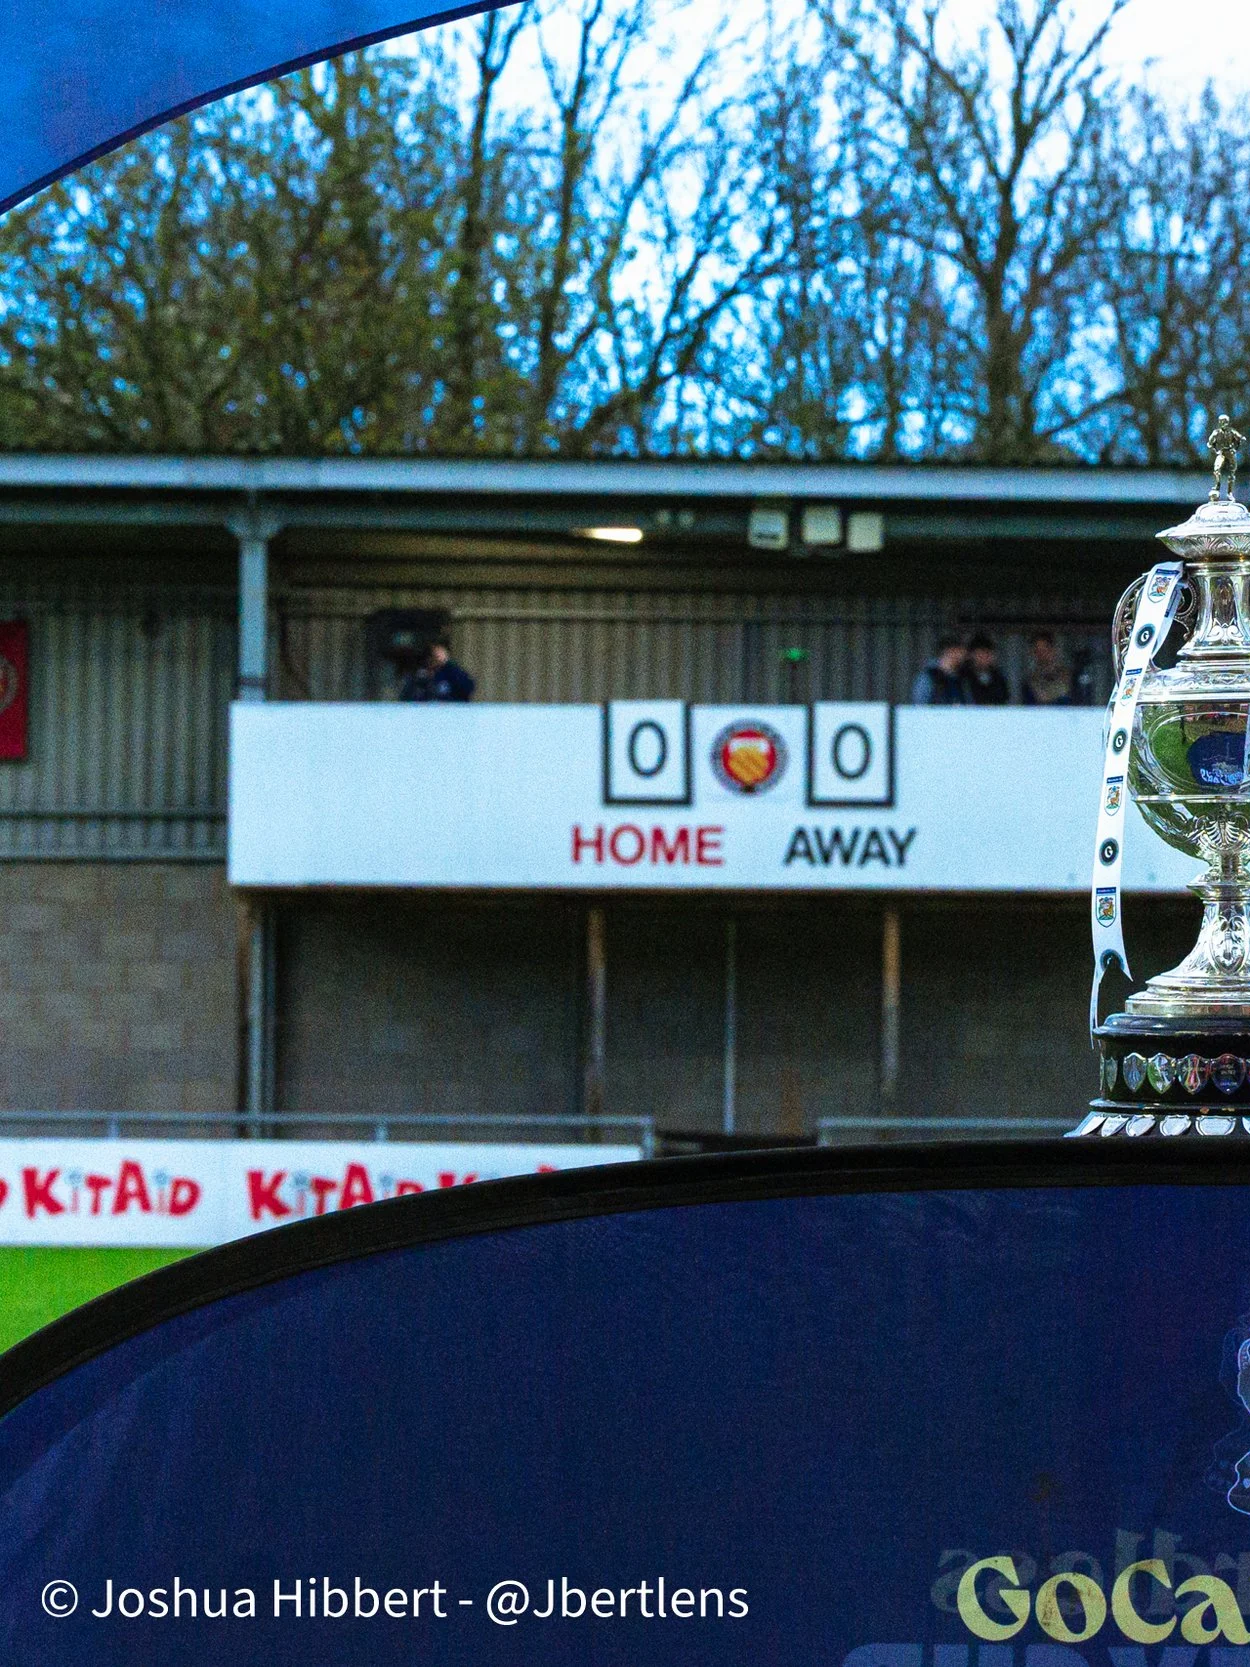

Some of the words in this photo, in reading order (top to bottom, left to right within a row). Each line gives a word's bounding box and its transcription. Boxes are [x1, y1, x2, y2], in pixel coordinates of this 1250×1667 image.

[627, 719, 668, 778] 0
[831, 722, 872, 781] 0
[572, 824, 725, 866] HOME
[783, 826, 917, 867] AWAY
